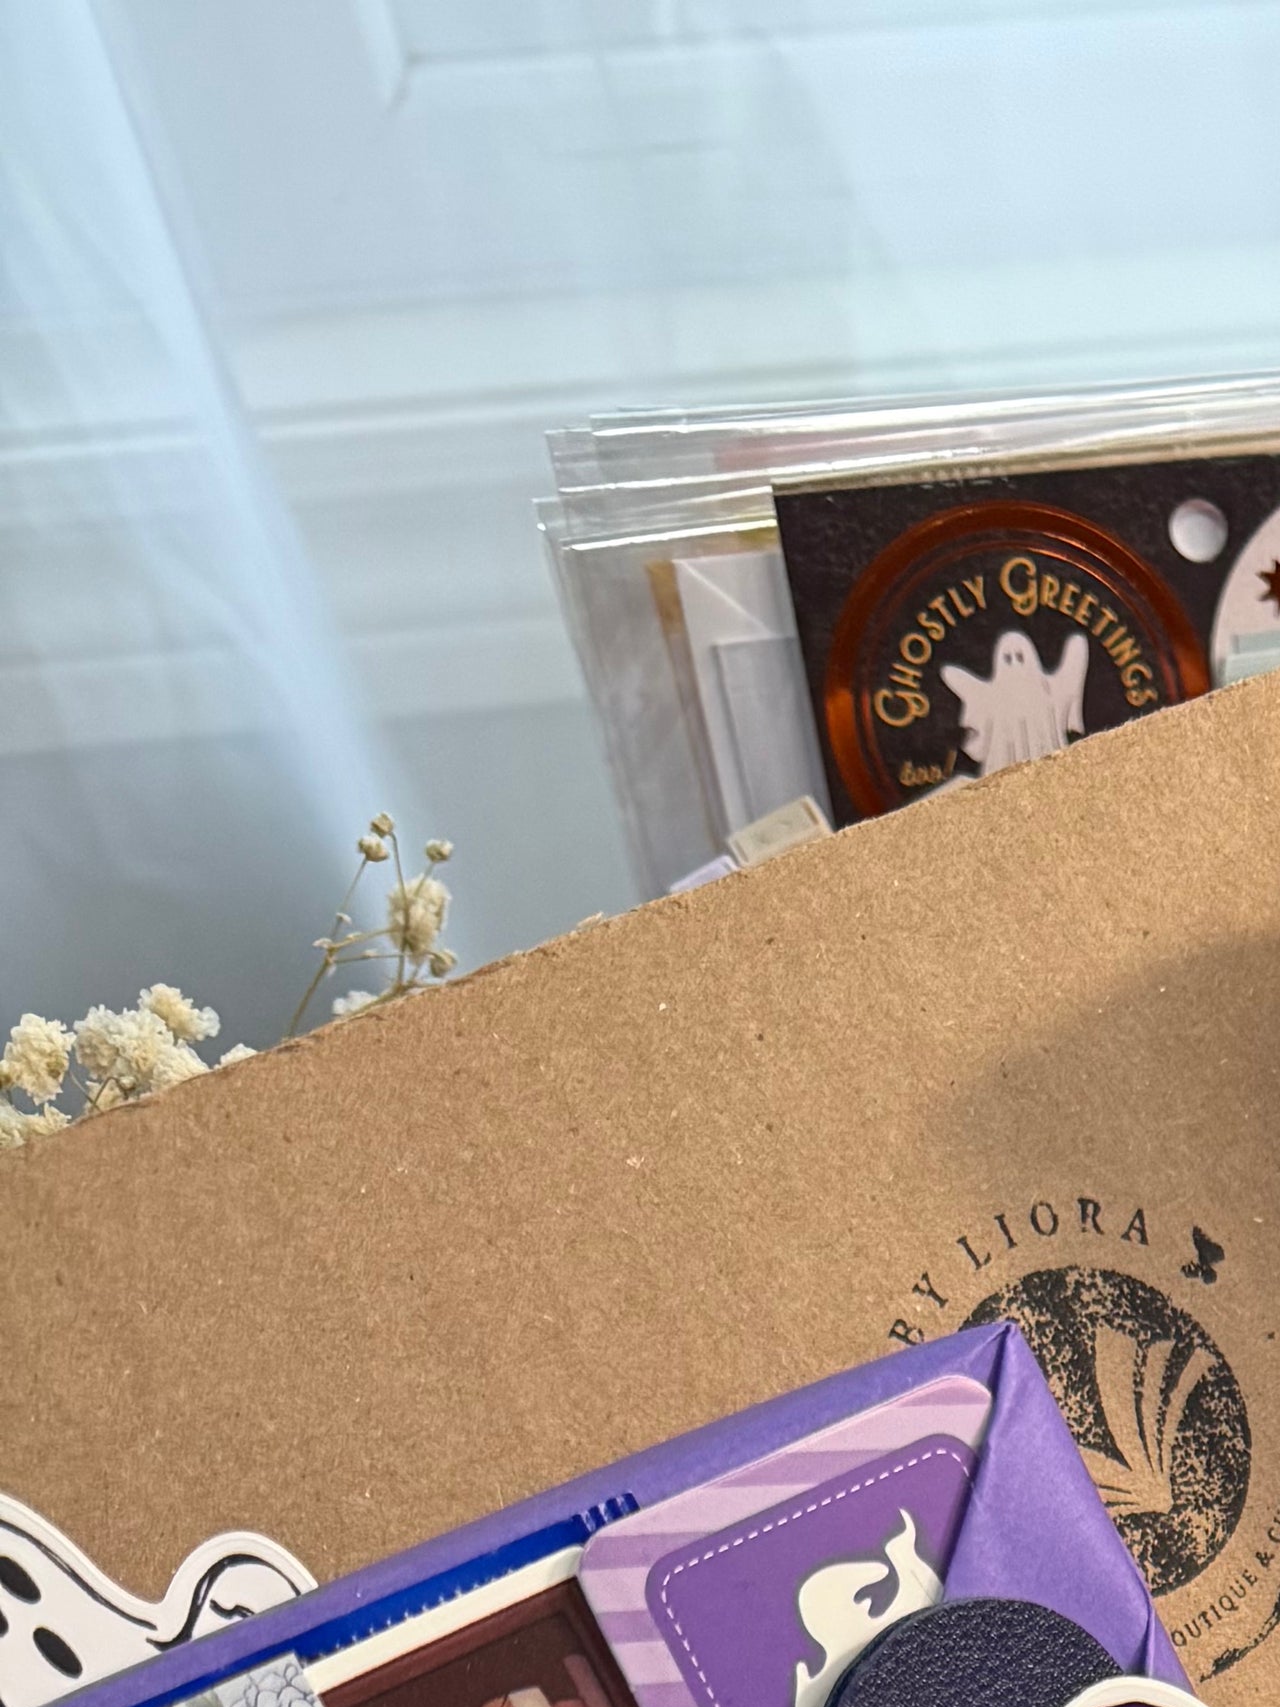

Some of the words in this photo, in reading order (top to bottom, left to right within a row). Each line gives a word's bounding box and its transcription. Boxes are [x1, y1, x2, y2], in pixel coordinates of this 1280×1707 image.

[889, 1272, 949, 1347] BY
[957, 1198, 1151, 1271] LIORA
[1171, 1569, 1257, 1647] OUTIQUE
